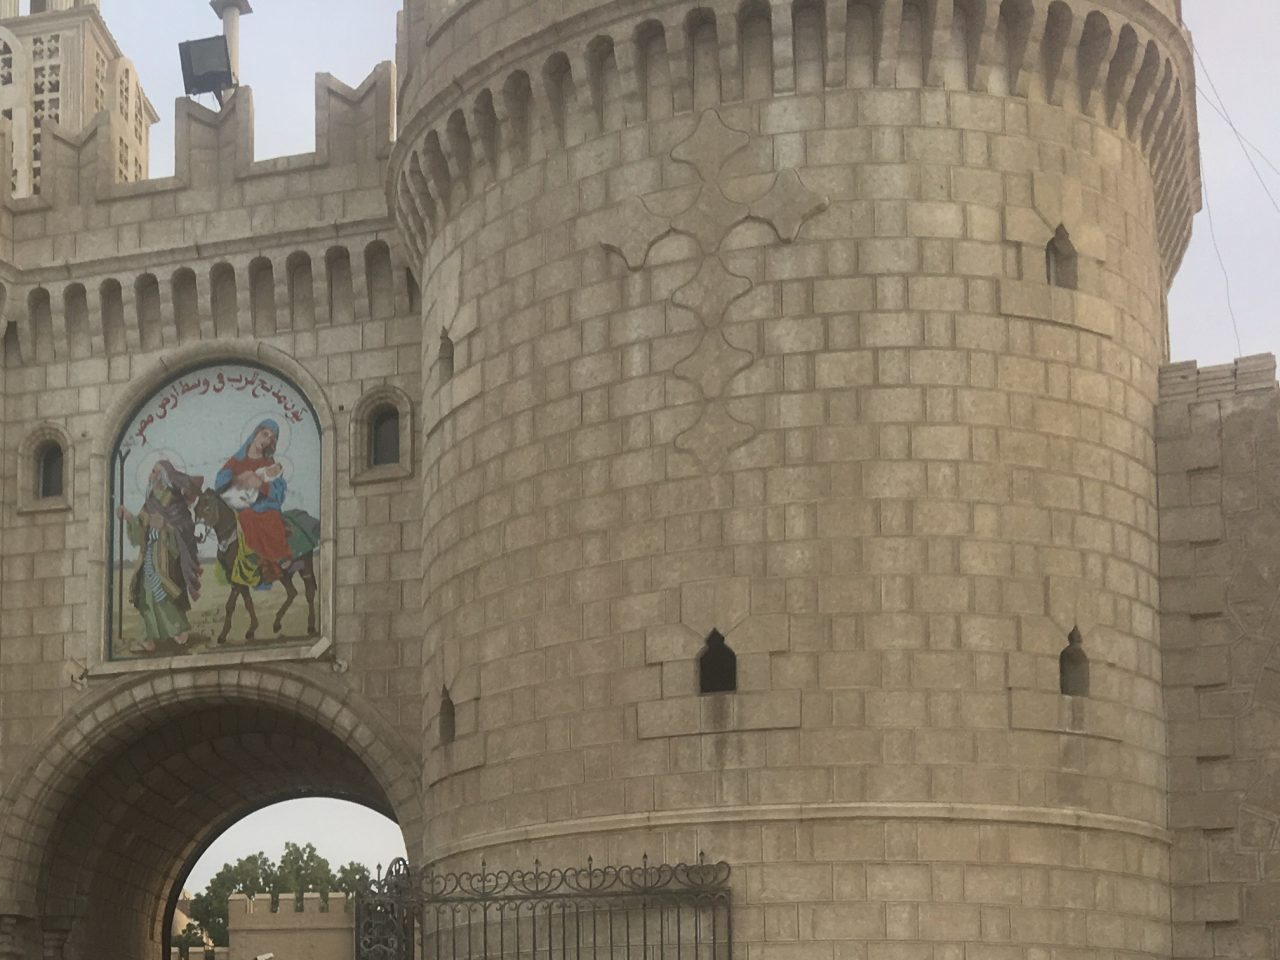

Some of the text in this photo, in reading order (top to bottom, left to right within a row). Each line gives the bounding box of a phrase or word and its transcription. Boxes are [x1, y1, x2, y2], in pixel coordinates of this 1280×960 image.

[179, 377, 210, 395] وسط
[252, 377, 287, 404] مذبح
[135, 414, 154, 446] مصر
